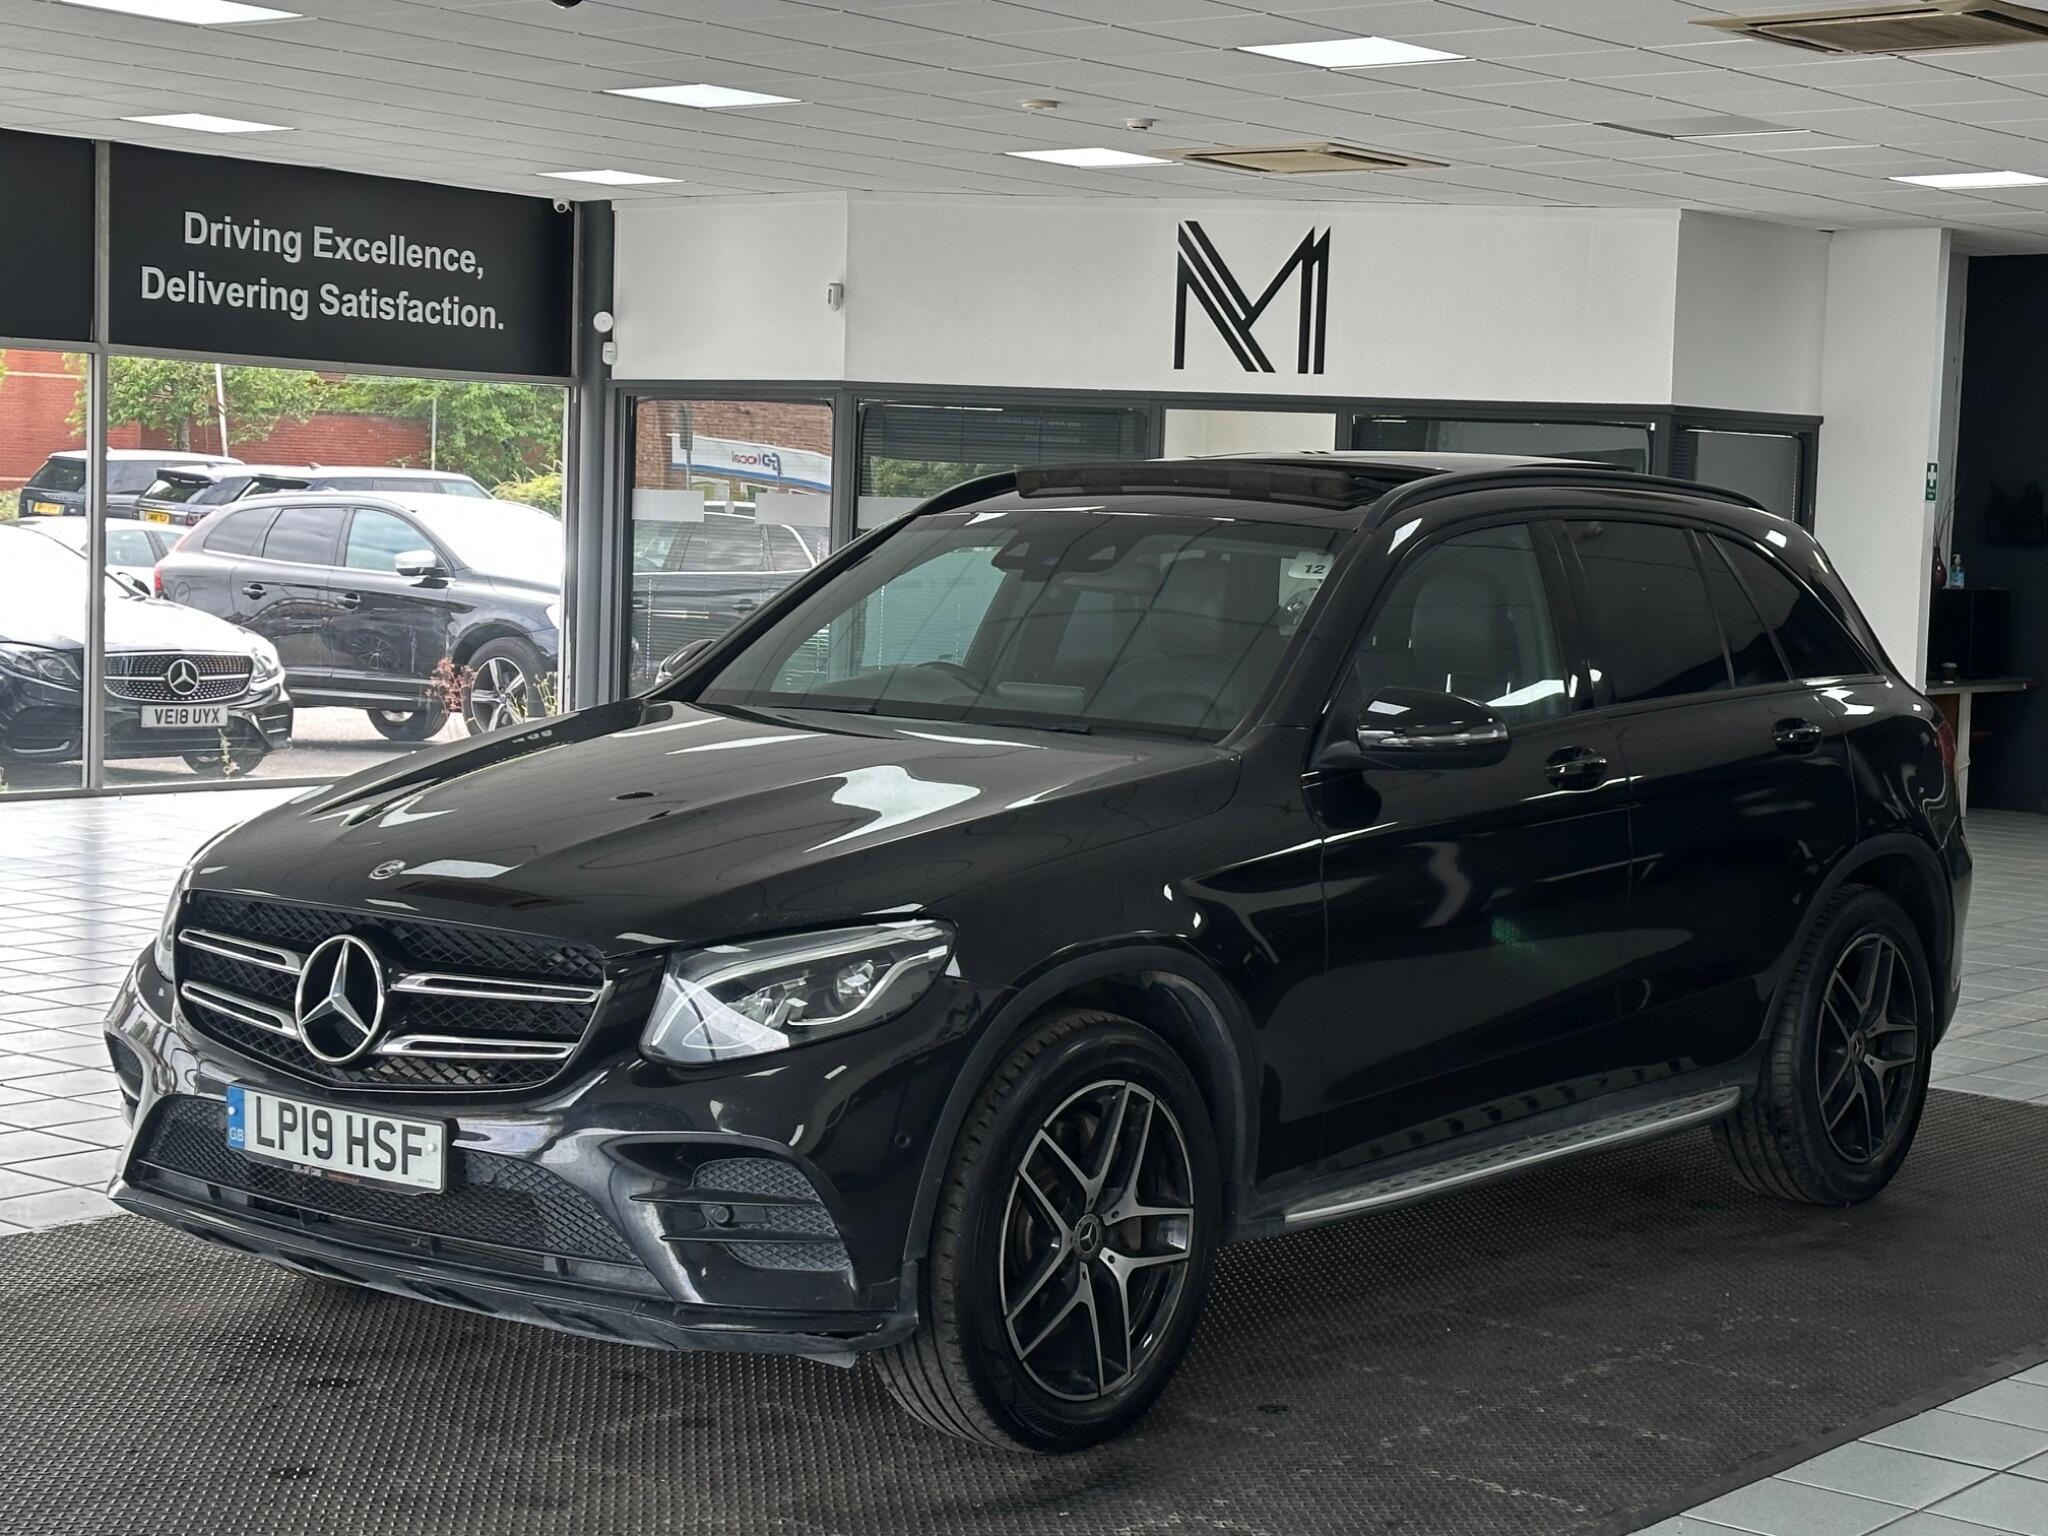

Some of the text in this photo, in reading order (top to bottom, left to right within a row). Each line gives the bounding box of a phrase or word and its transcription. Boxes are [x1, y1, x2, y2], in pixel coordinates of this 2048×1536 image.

[184, 210, 484, 280] Driving Excellence,
[141, 266, 505, 330] Delivering Satisfaction.
[1304, 564, 1326, 575] 12
[154, 707, 220, 725] VE18 UYX
[229, 1126, 245, 1142] GB
[256, 1095, 426, 1175] LP19 HSF
